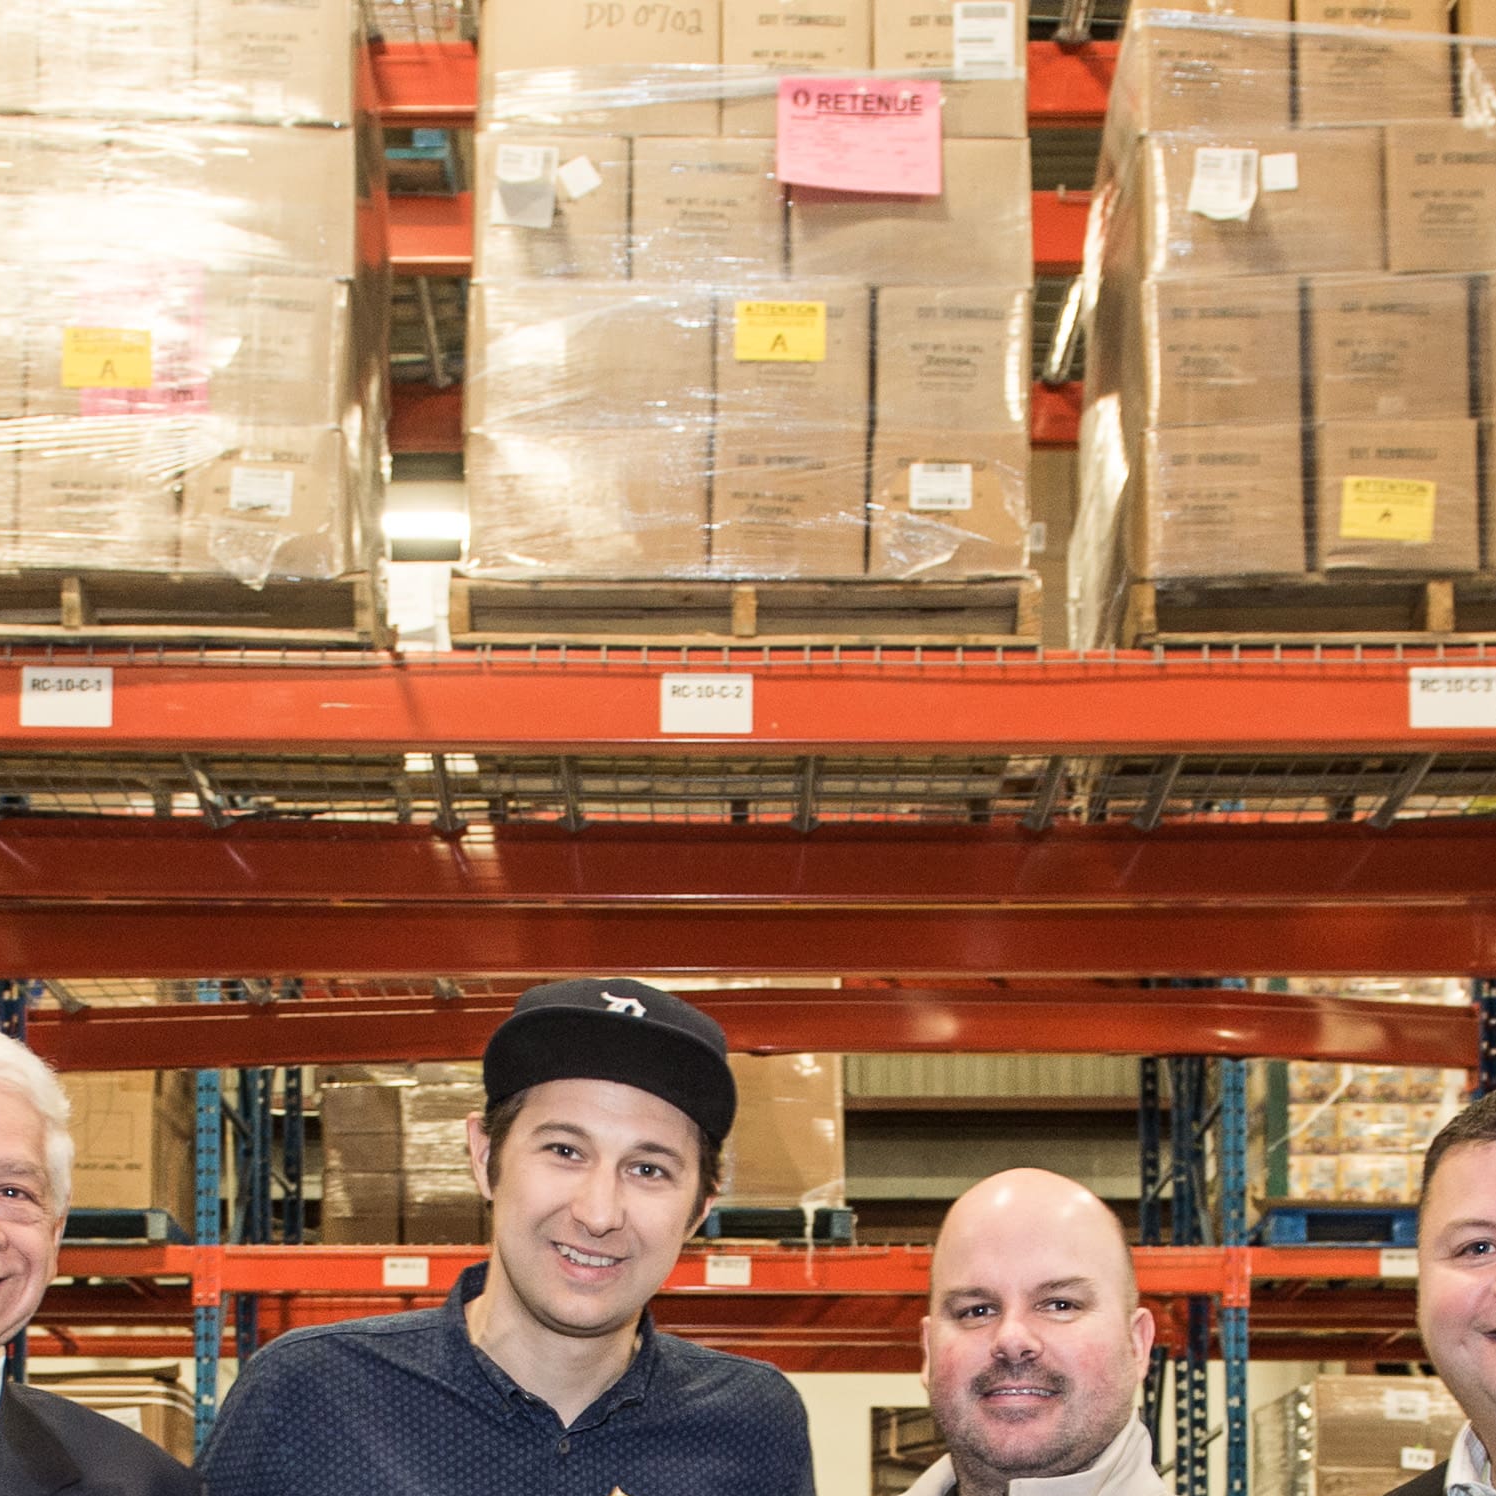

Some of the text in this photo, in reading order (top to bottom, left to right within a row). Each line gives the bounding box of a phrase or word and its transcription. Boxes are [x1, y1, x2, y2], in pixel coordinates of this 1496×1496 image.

[816, 93, 923, 112] RETENUE
[770, 334, 788, 352] A
[99, 358, 118, 379] A
[31, 678, 103, 692] RC-10-C-1
[671, 685, 744, 699] RC-10-C-2
